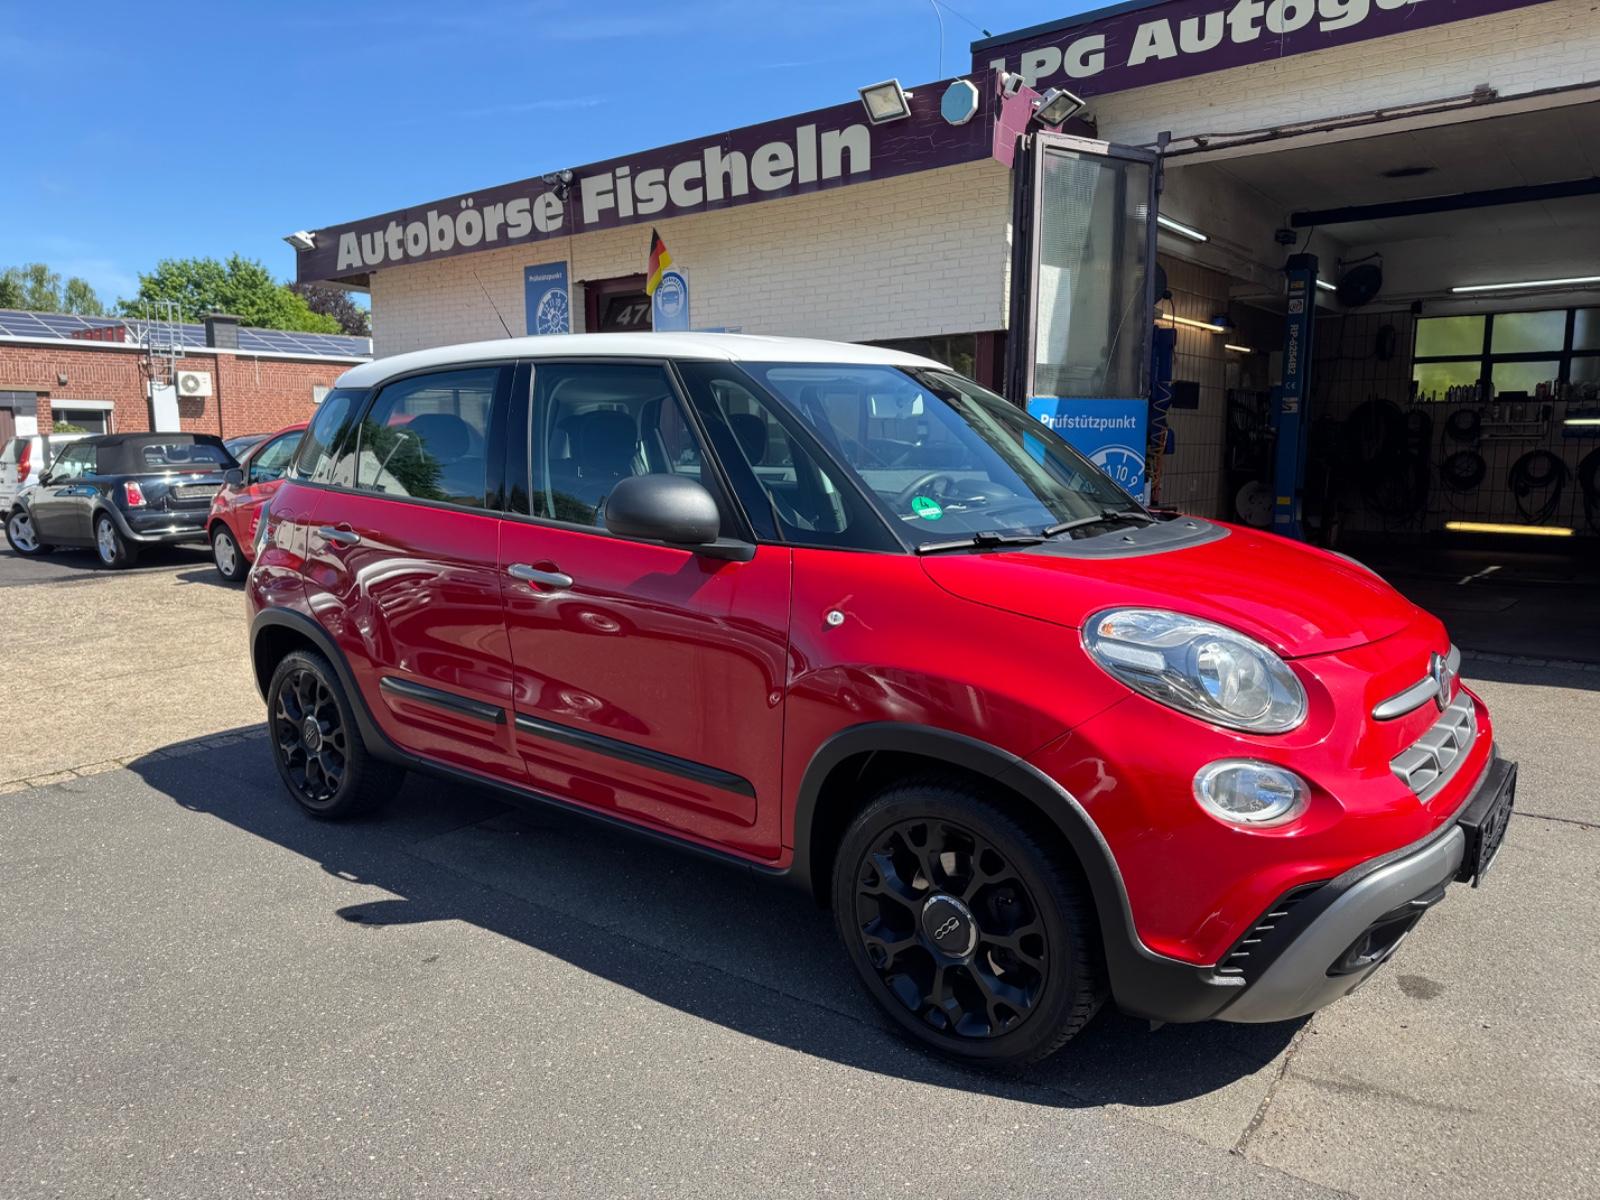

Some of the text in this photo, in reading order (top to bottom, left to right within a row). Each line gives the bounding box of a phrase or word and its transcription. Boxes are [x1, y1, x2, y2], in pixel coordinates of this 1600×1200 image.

[1127, 0, 1426, 67] Autog
[336, 123, 871, 271] Autobörse Fischeln
[1040, 413, 1136, 431] Prüfstützpunkt
[1116, 464, 1128, 481] 10
[1127, 475, 1138, 488] 9
